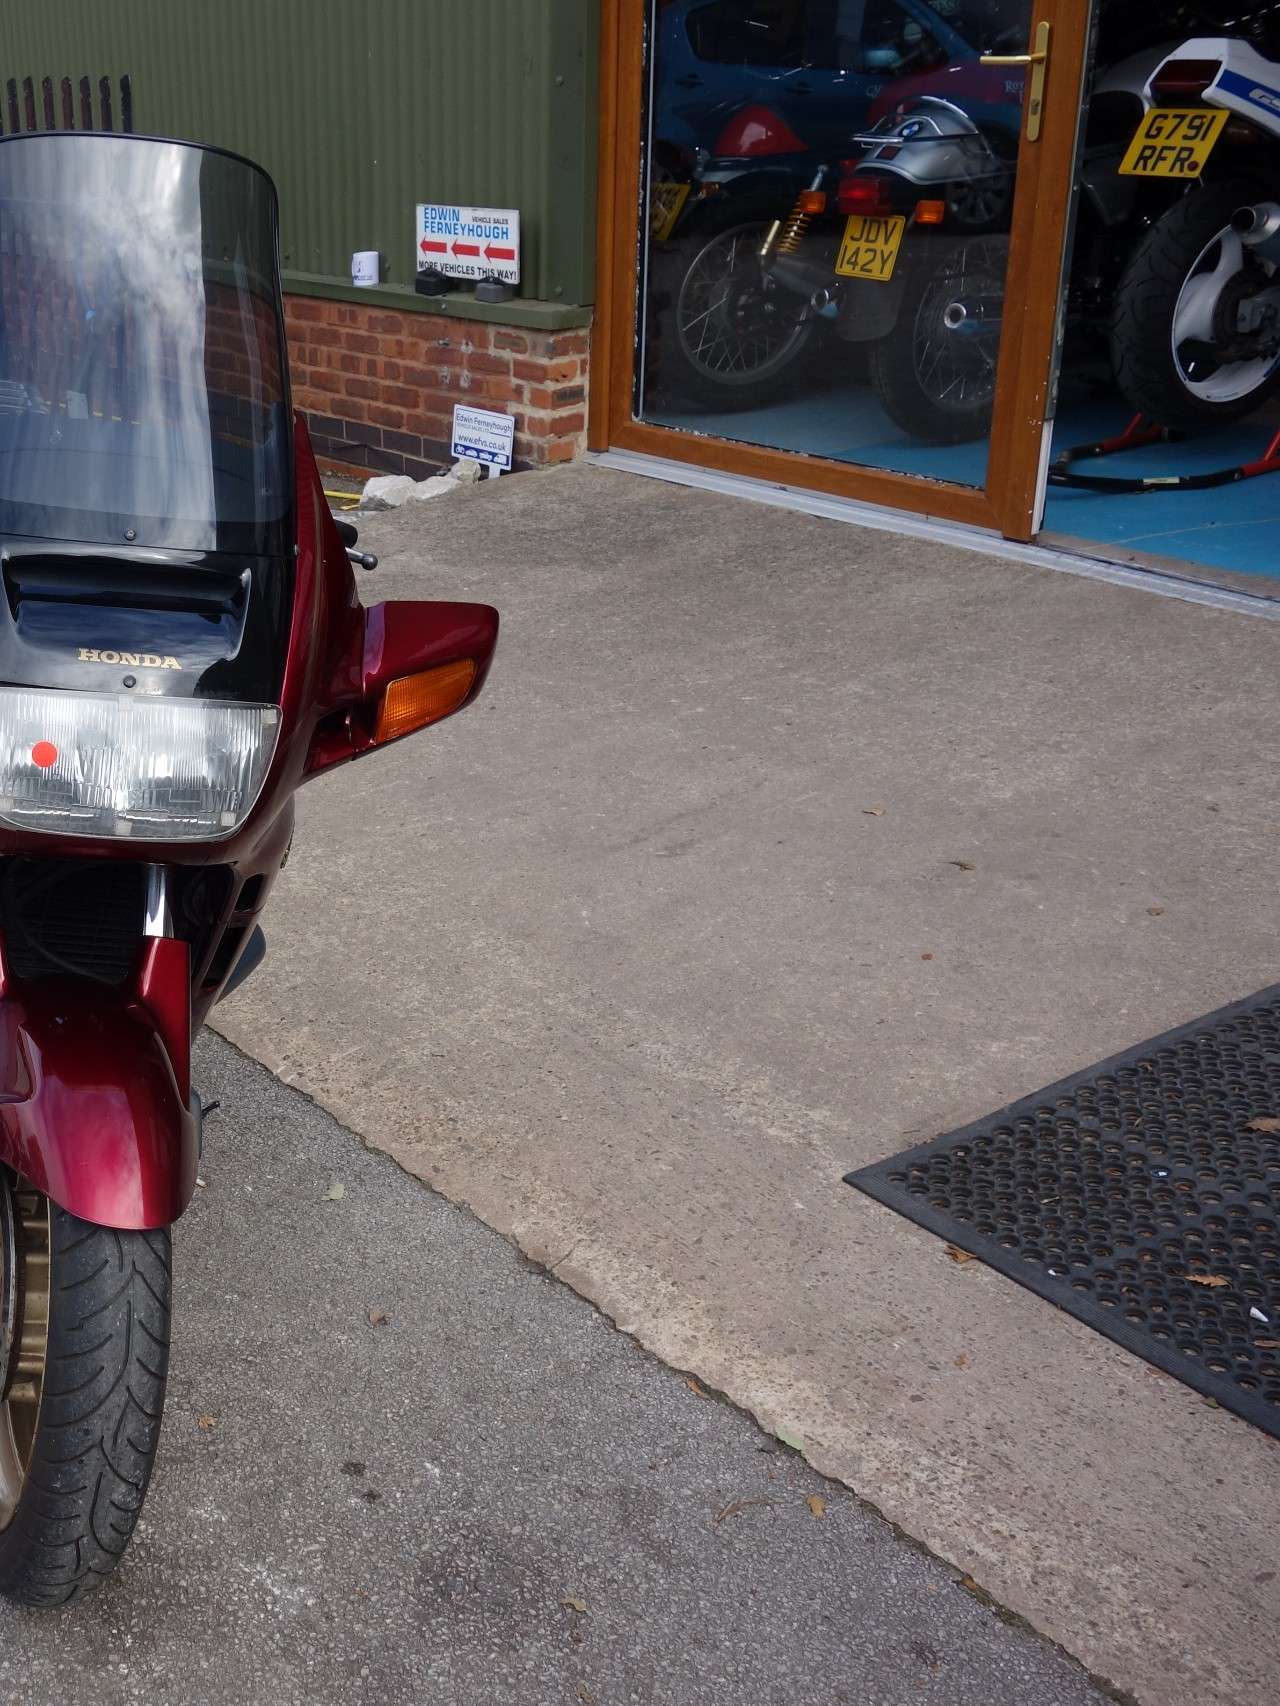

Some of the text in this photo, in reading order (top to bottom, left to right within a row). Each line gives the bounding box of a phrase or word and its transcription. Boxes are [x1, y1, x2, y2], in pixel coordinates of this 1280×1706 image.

[1144, 114, 1216, 141] G791
[1132, 144, 1195, 173] RFR
[424, 207, 460, 222] EDWIN
[472, 215, 509, 225] VEHICLE SALES
[424, 220, 509, 240] FERNEYHOUGH
[850, 218, 899, 246] JDV
[418, 260, 517, 281] MORE VEHICLES THIS WAY!
[839, 245, 894, 275] 142Y
[456, 414, 511, 434] Edwin Ferneyhough
[78, 648, 183, 670] HONDA
